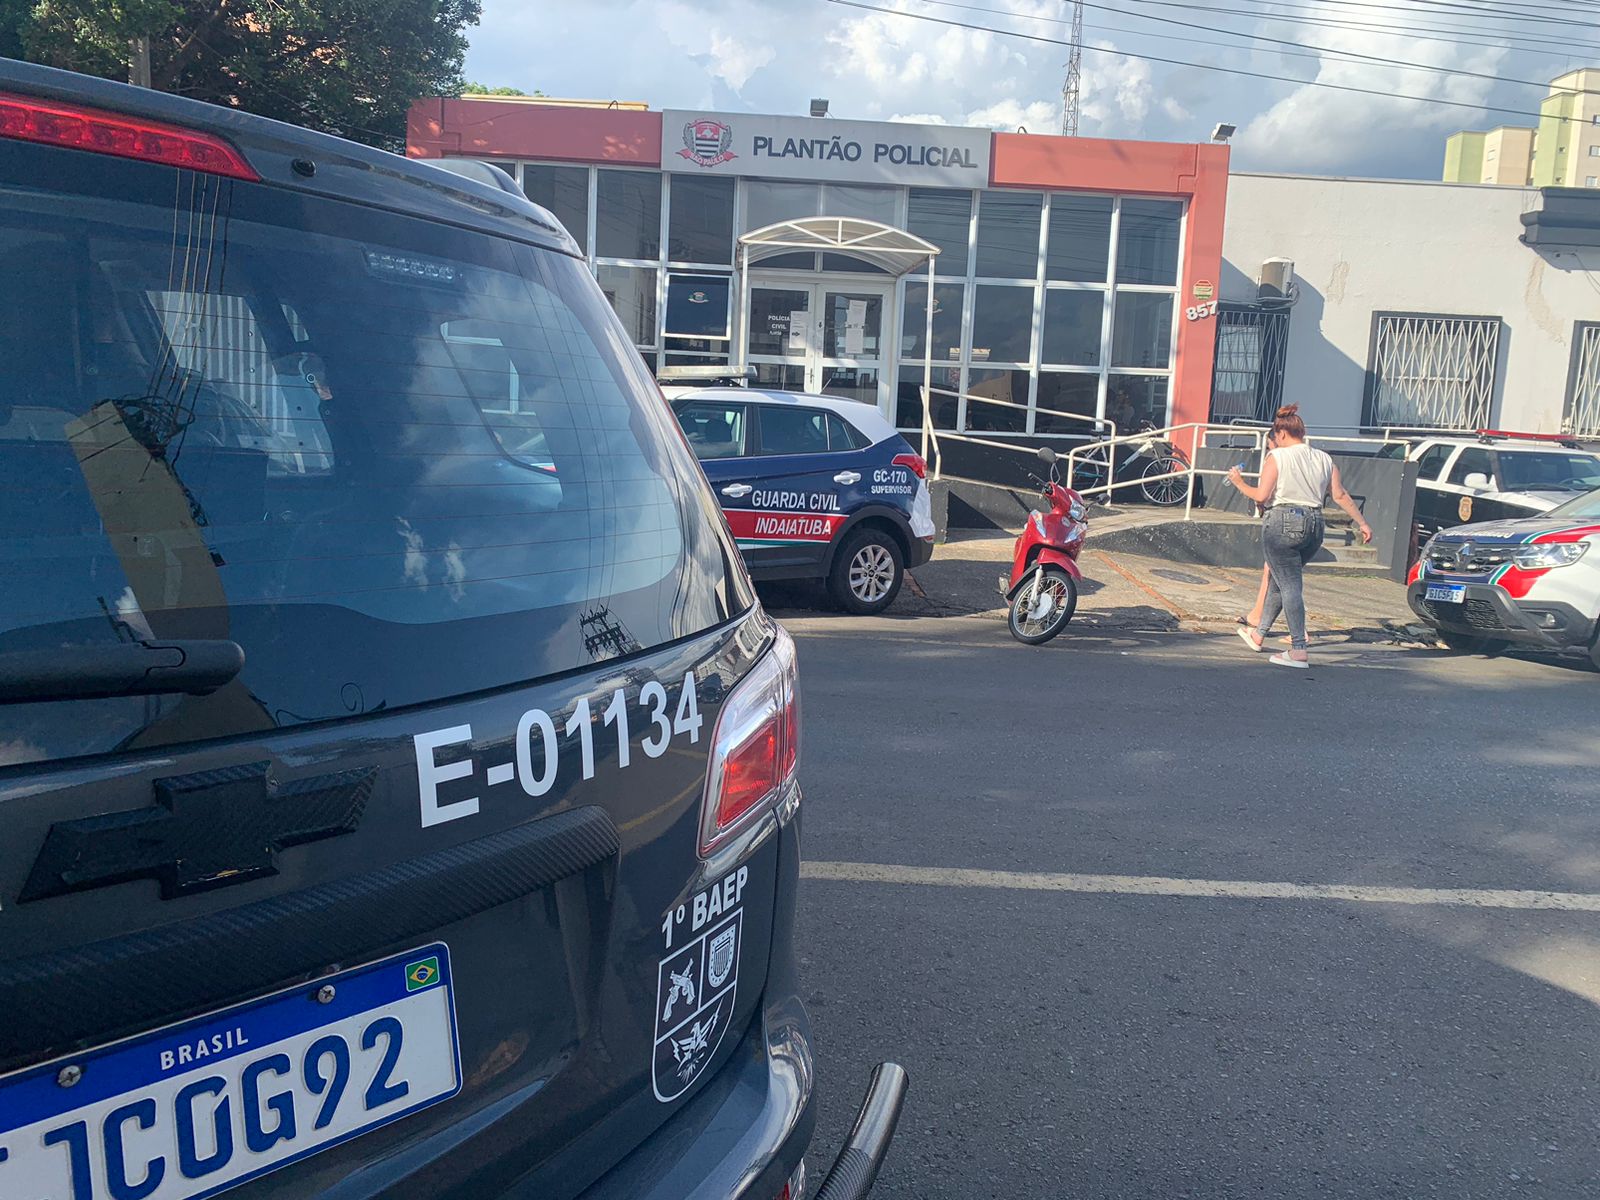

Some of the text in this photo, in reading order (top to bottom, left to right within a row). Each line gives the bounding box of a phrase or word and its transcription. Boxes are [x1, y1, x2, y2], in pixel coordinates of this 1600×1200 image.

[753, 135, 978, 169] PLANTÃO POLICIAL
[1185, 300, 1218, 321] 857
[873, 470, 907, 484] GC-170
[871, 485, 912, 494] SUPERVISOR
[752, 490, 841, 511] GUARDA CIVIL
[755, 517, 832, 535] INDAIATUBA
[413, 671, 703, 829] E-01134
[691, 865, 749, 933] BAEP
[160, 1027, 249, 1071] BRASIL
